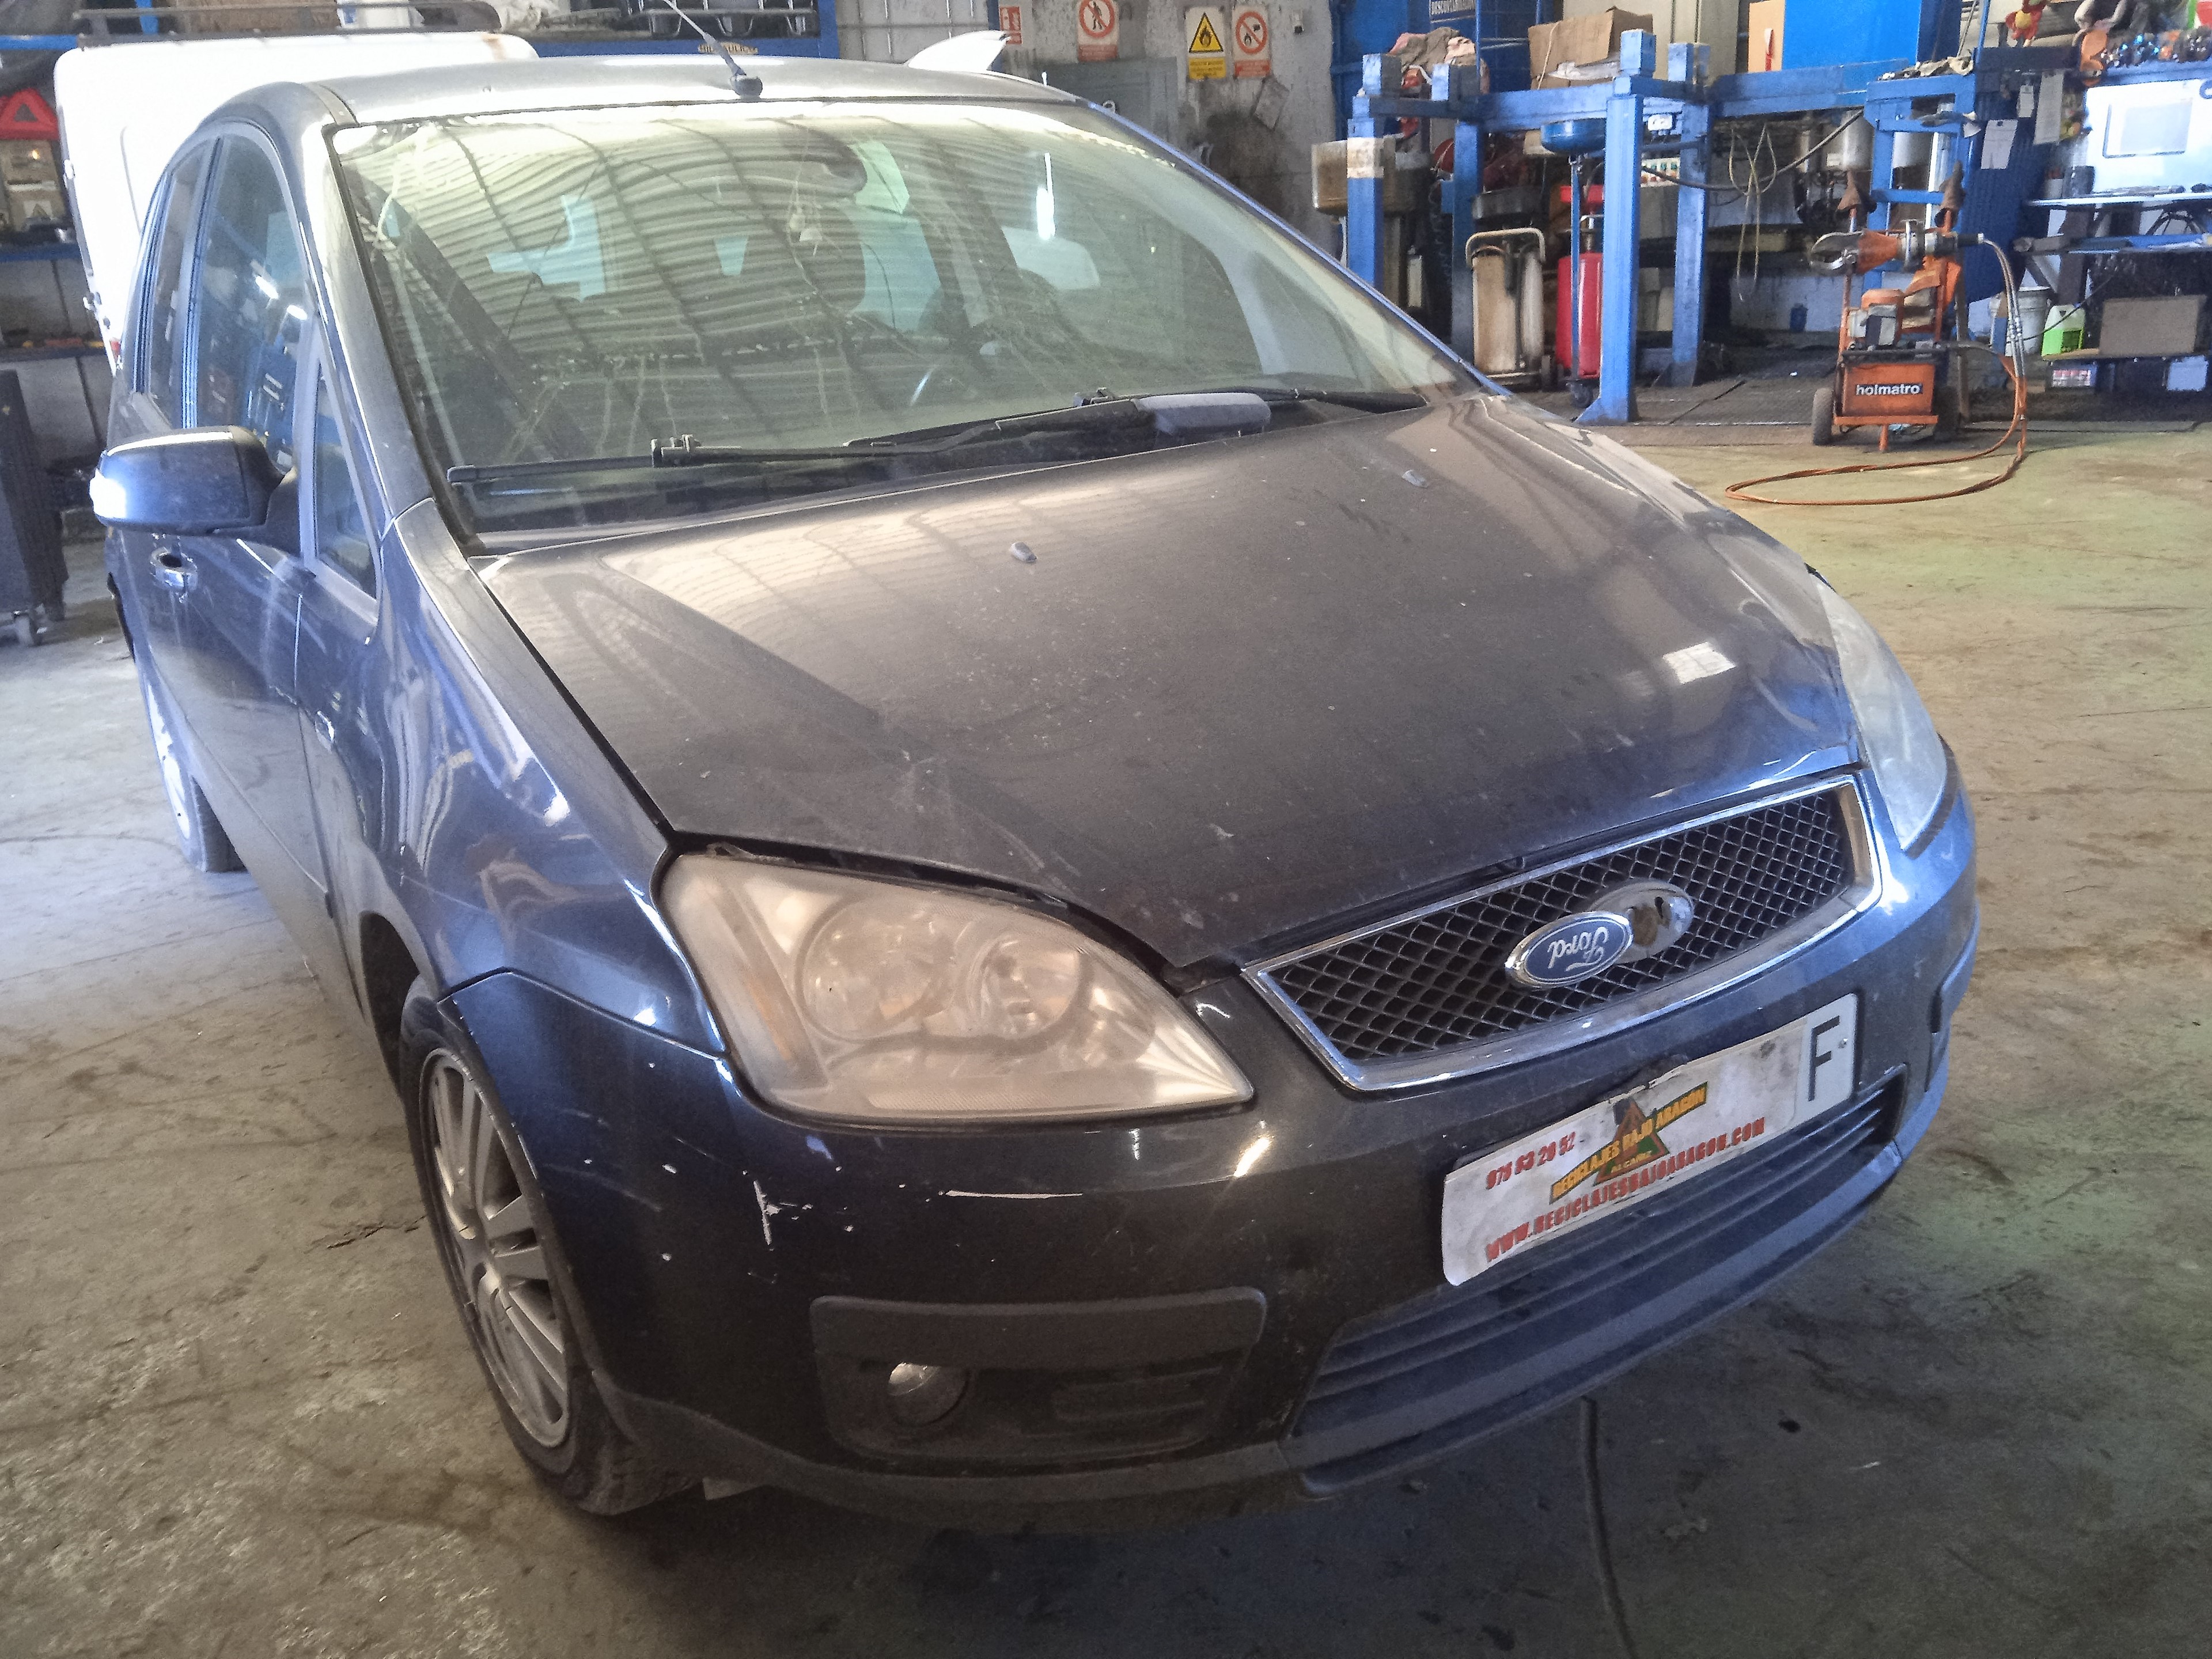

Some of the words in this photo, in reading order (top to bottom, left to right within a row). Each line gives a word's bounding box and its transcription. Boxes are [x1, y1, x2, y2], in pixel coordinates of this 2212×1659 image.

[1856, 384, 1920, 396] holmatro
[1547, 926, 1609, 971] Ford
[1808, 1015, 1840, 1102] F
